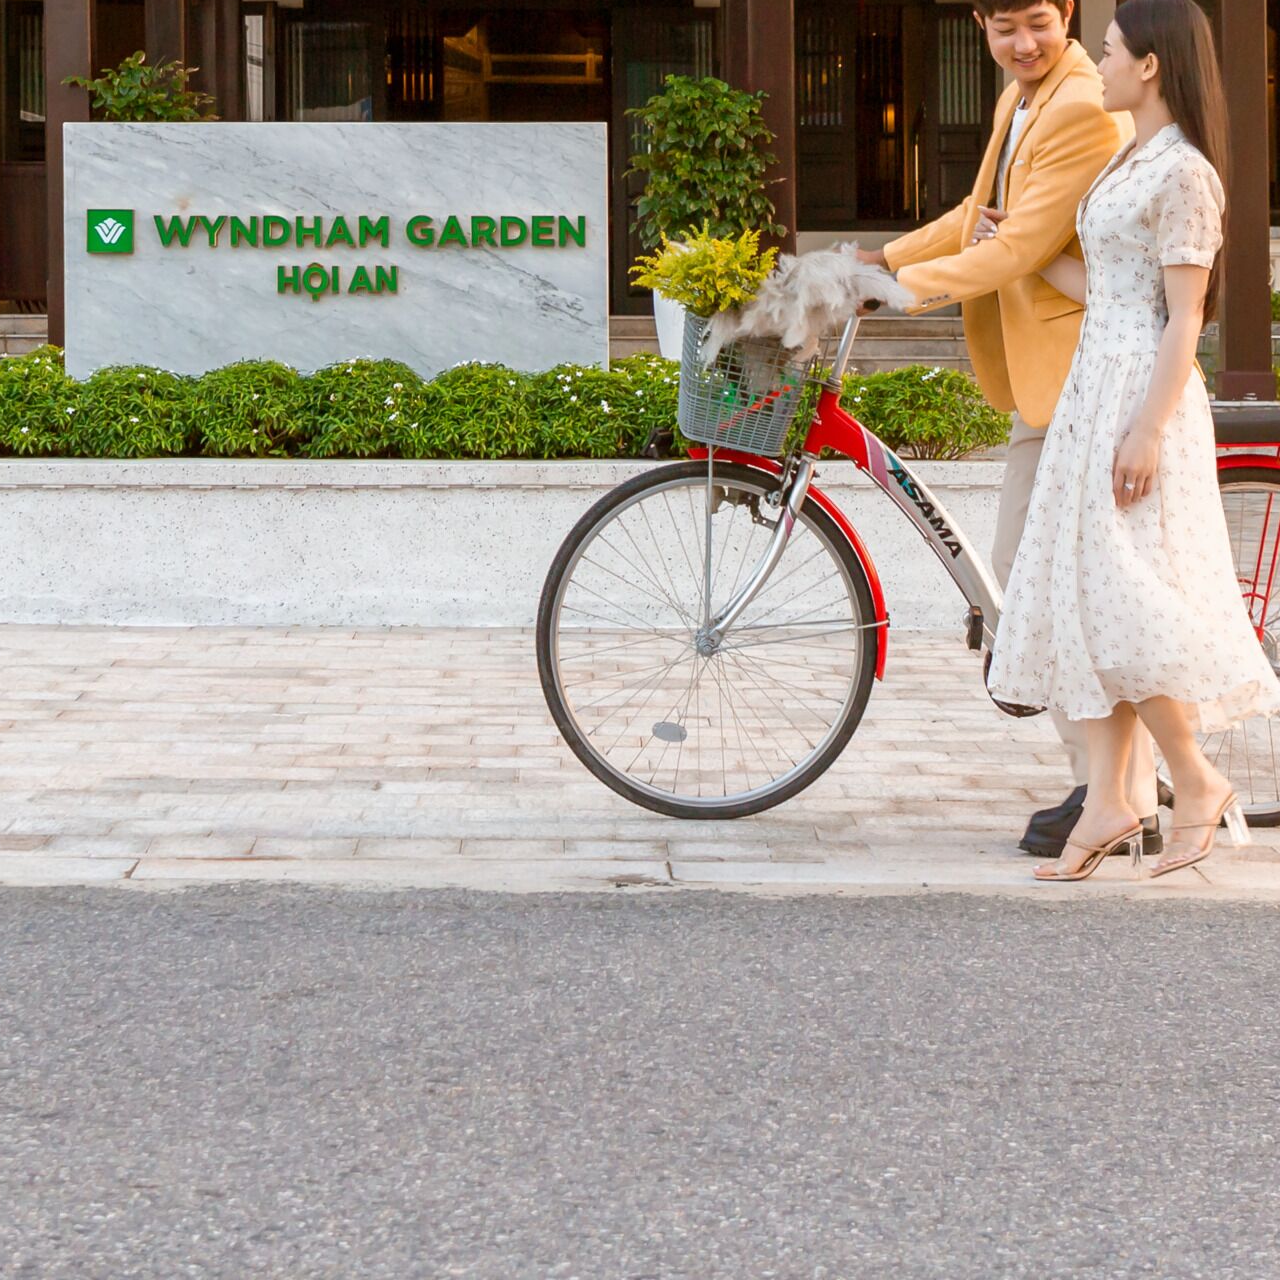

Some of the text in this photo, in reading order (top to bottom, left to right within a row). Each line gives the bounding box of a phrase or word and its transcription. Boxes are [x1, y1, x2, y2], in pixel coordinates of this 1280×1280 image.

[153, 214, 586, 249] WYNDHAM GARDEN
[277, 262, 399, 302] HỘI AN
[887, 469, 963, 559] ASAMA
